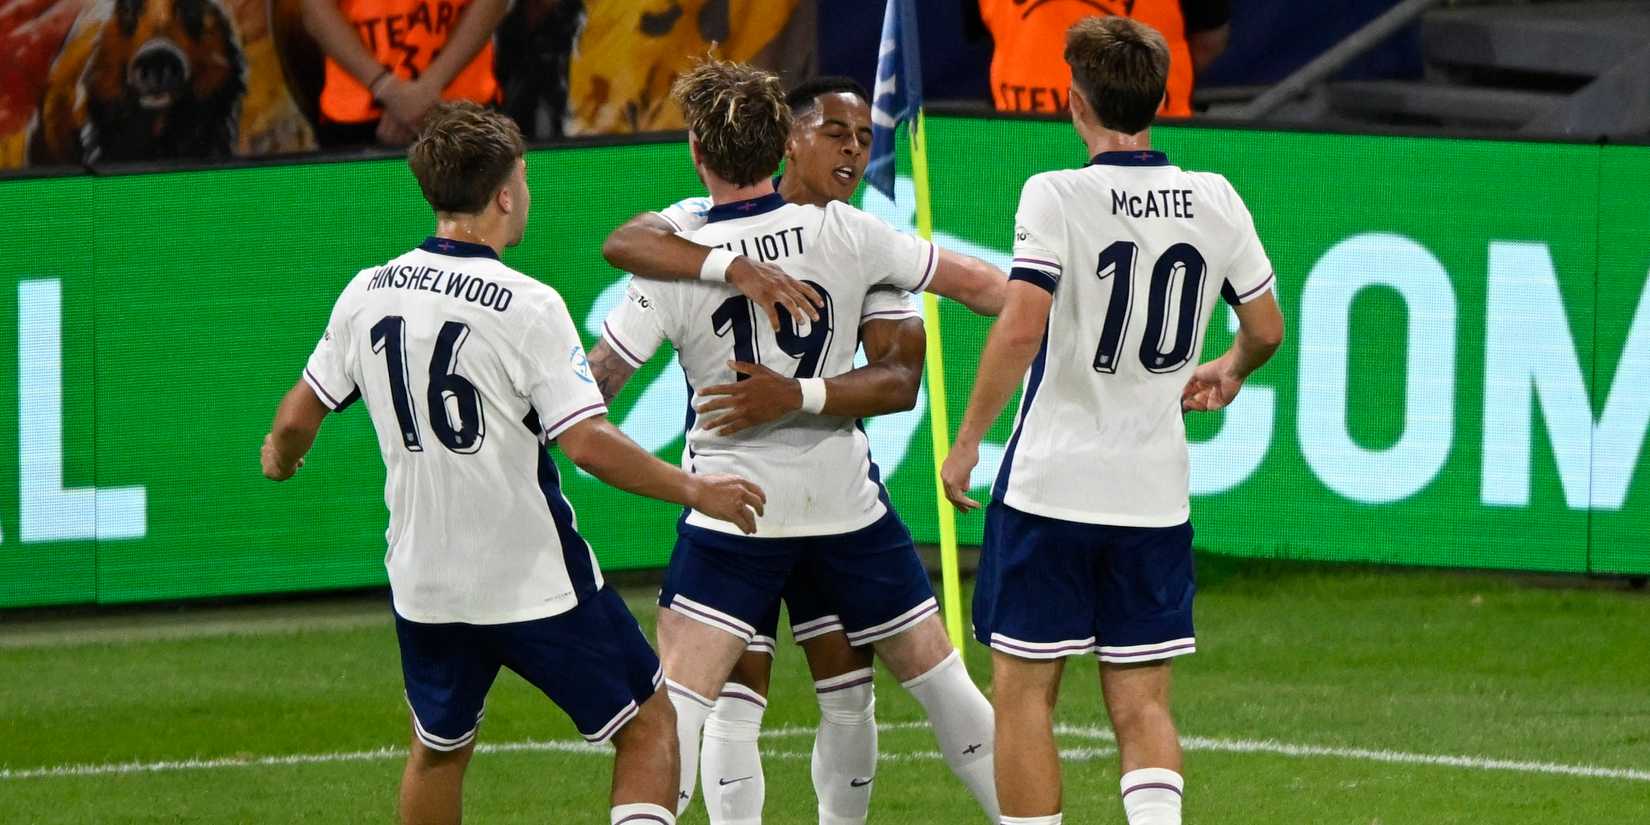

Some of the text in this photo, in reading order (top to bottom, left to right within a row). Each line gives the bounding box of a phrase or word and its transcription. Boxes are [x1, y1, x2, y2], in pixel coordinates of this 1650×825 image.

[1111, 188, 1194, 218] McATEE
[713, 226, 804, 263] IOTT
[366, 265, 513, 312] HINSHELWOOD
[1093, 240, 1208, 375] 10
[711, 279, 835, 382] 19
[370, 315, 486, 455] 16
